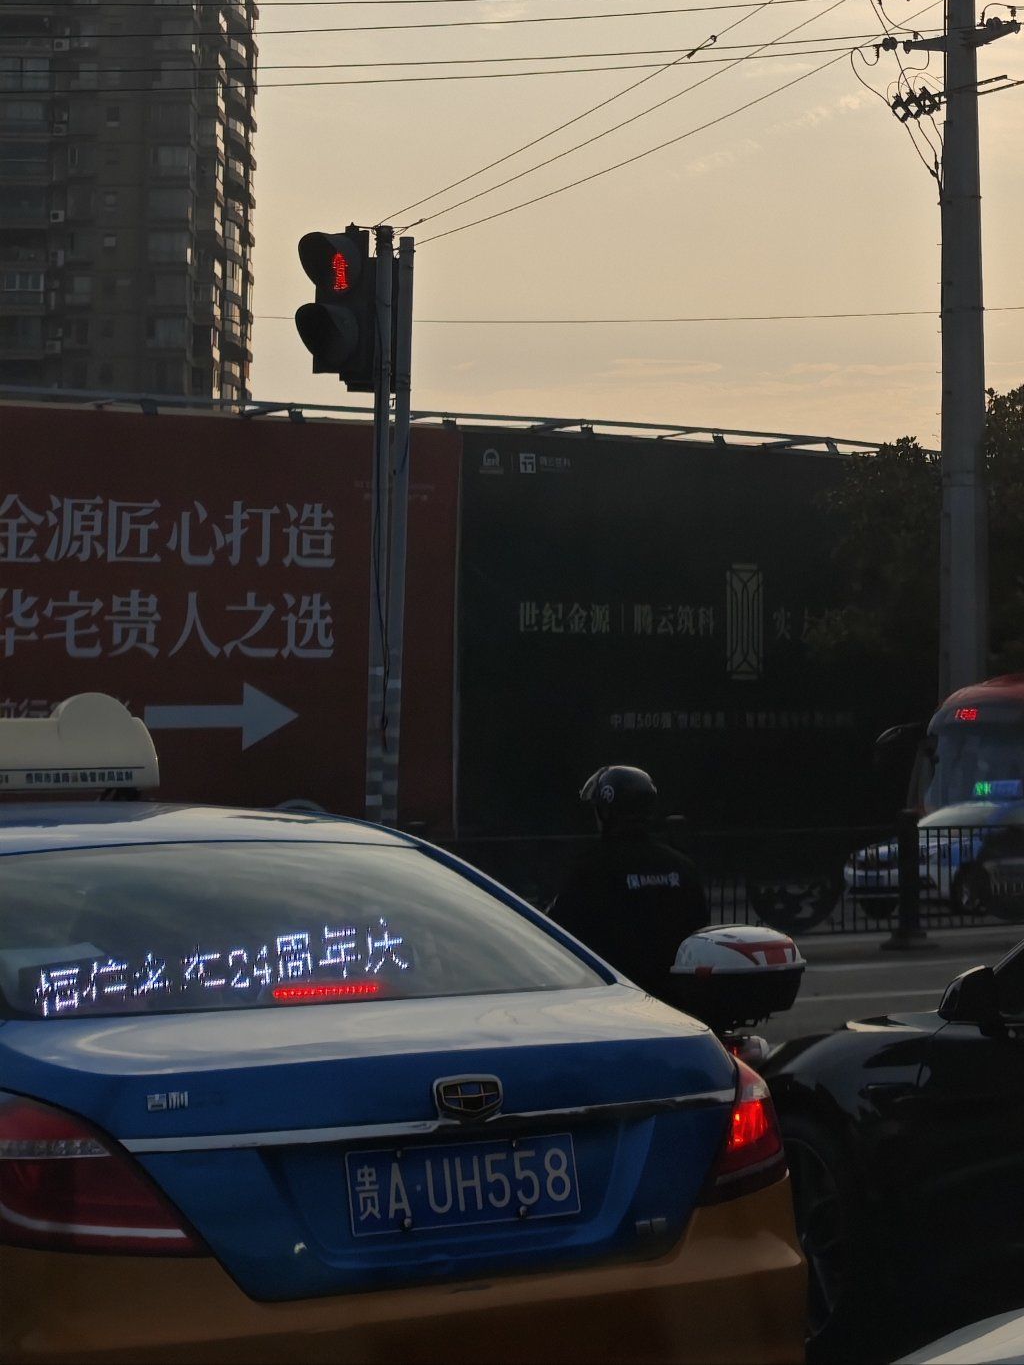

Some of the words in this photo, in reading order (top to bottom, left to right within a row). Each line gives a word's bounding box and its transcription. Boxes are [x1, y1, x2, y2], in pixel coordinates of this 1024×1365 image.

[0, 493, 336, 569] 金源匠心打造
[146, 1090, 190, 1112] 吉利
